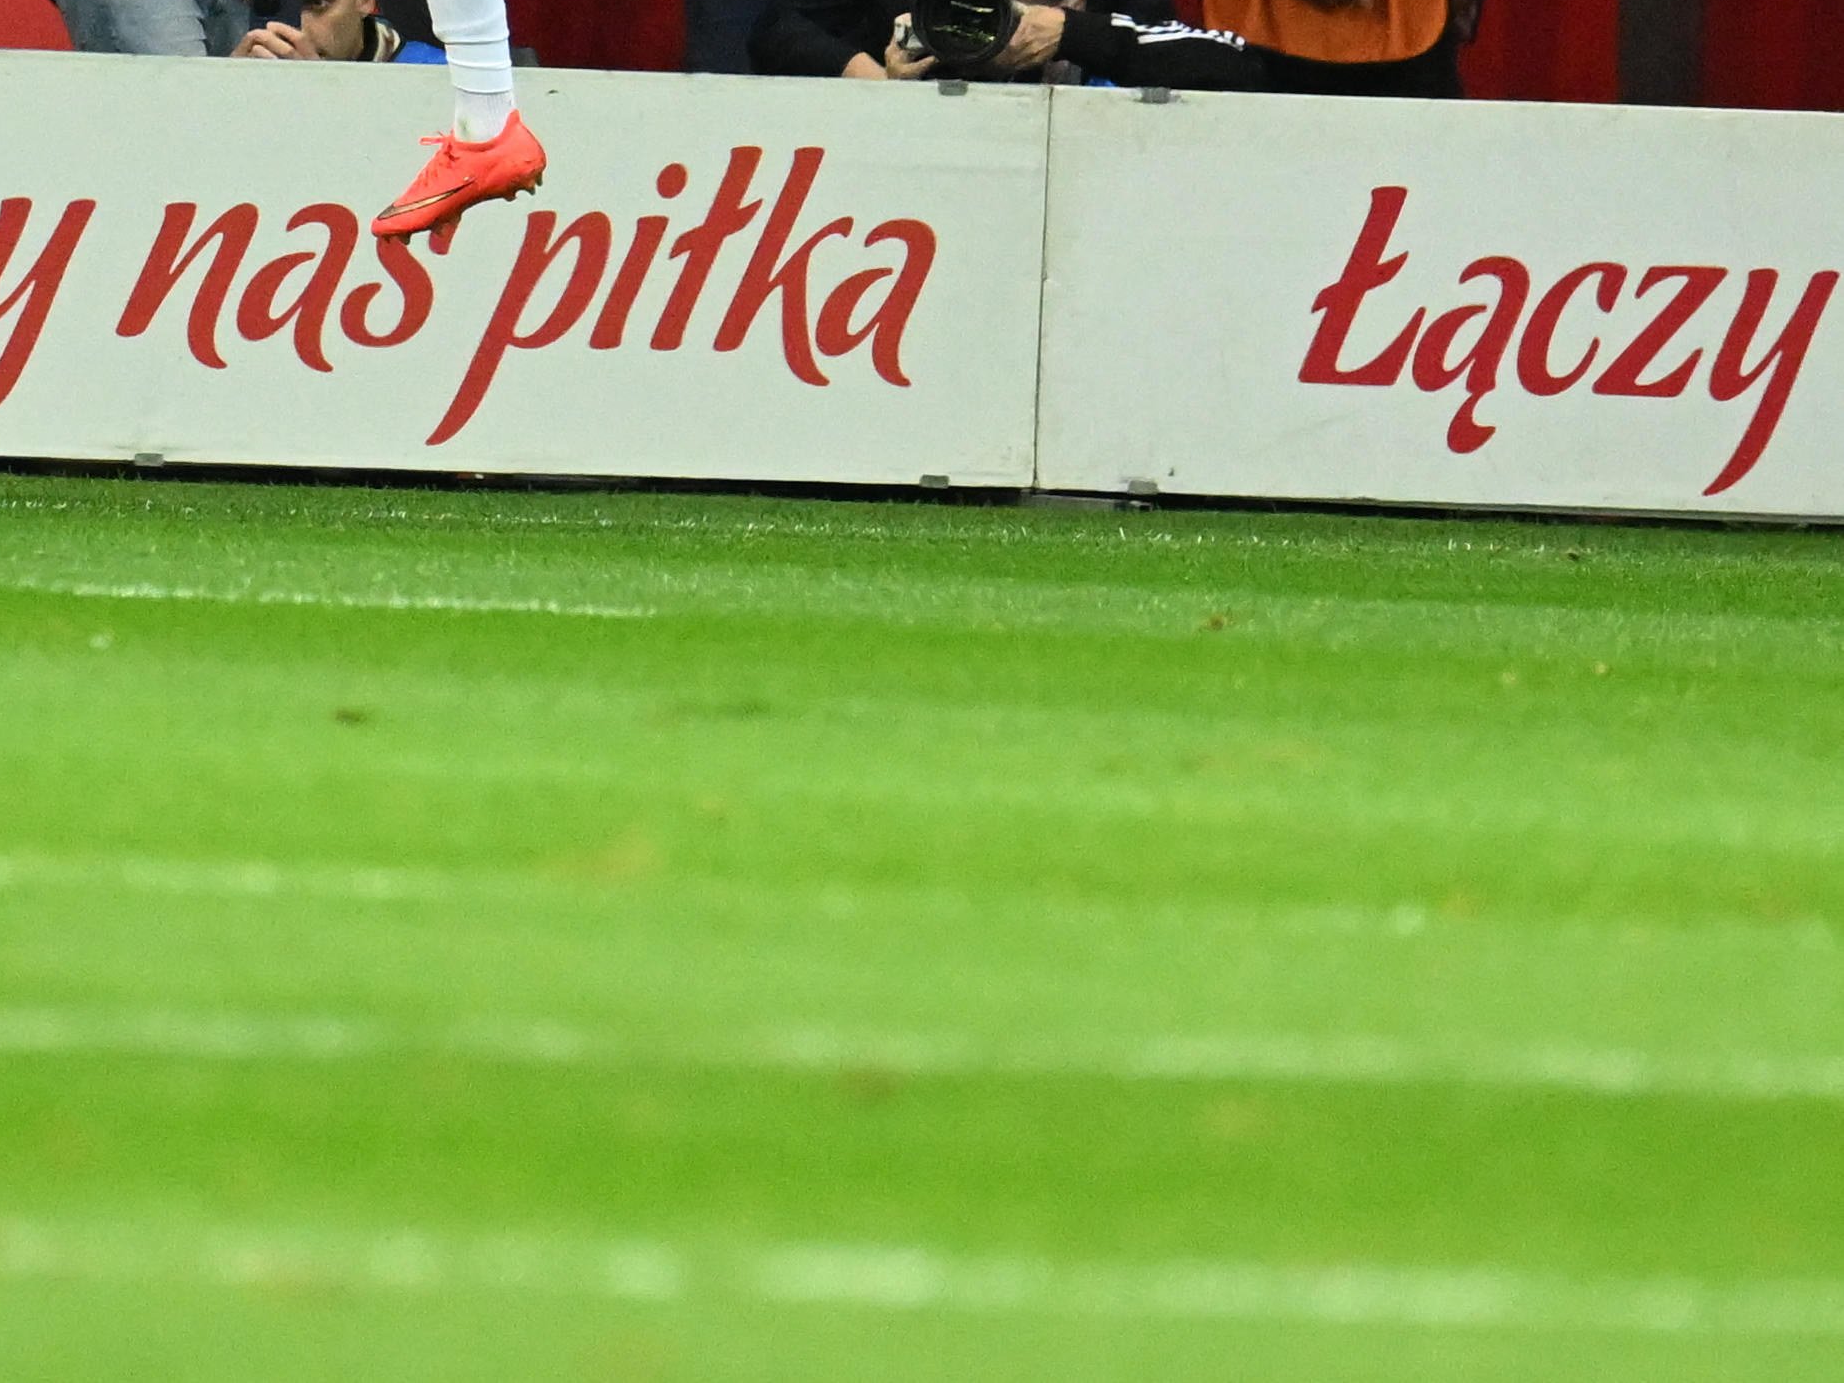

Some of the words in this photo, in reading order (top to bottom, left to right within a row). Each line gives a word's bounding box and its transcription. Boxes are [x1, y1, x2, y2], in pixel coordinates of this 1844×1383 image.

[116, 201, 436, 373] nas
[425, 144, 938, 447] piłka
[1297, 185, 1841, 497] Łączy
